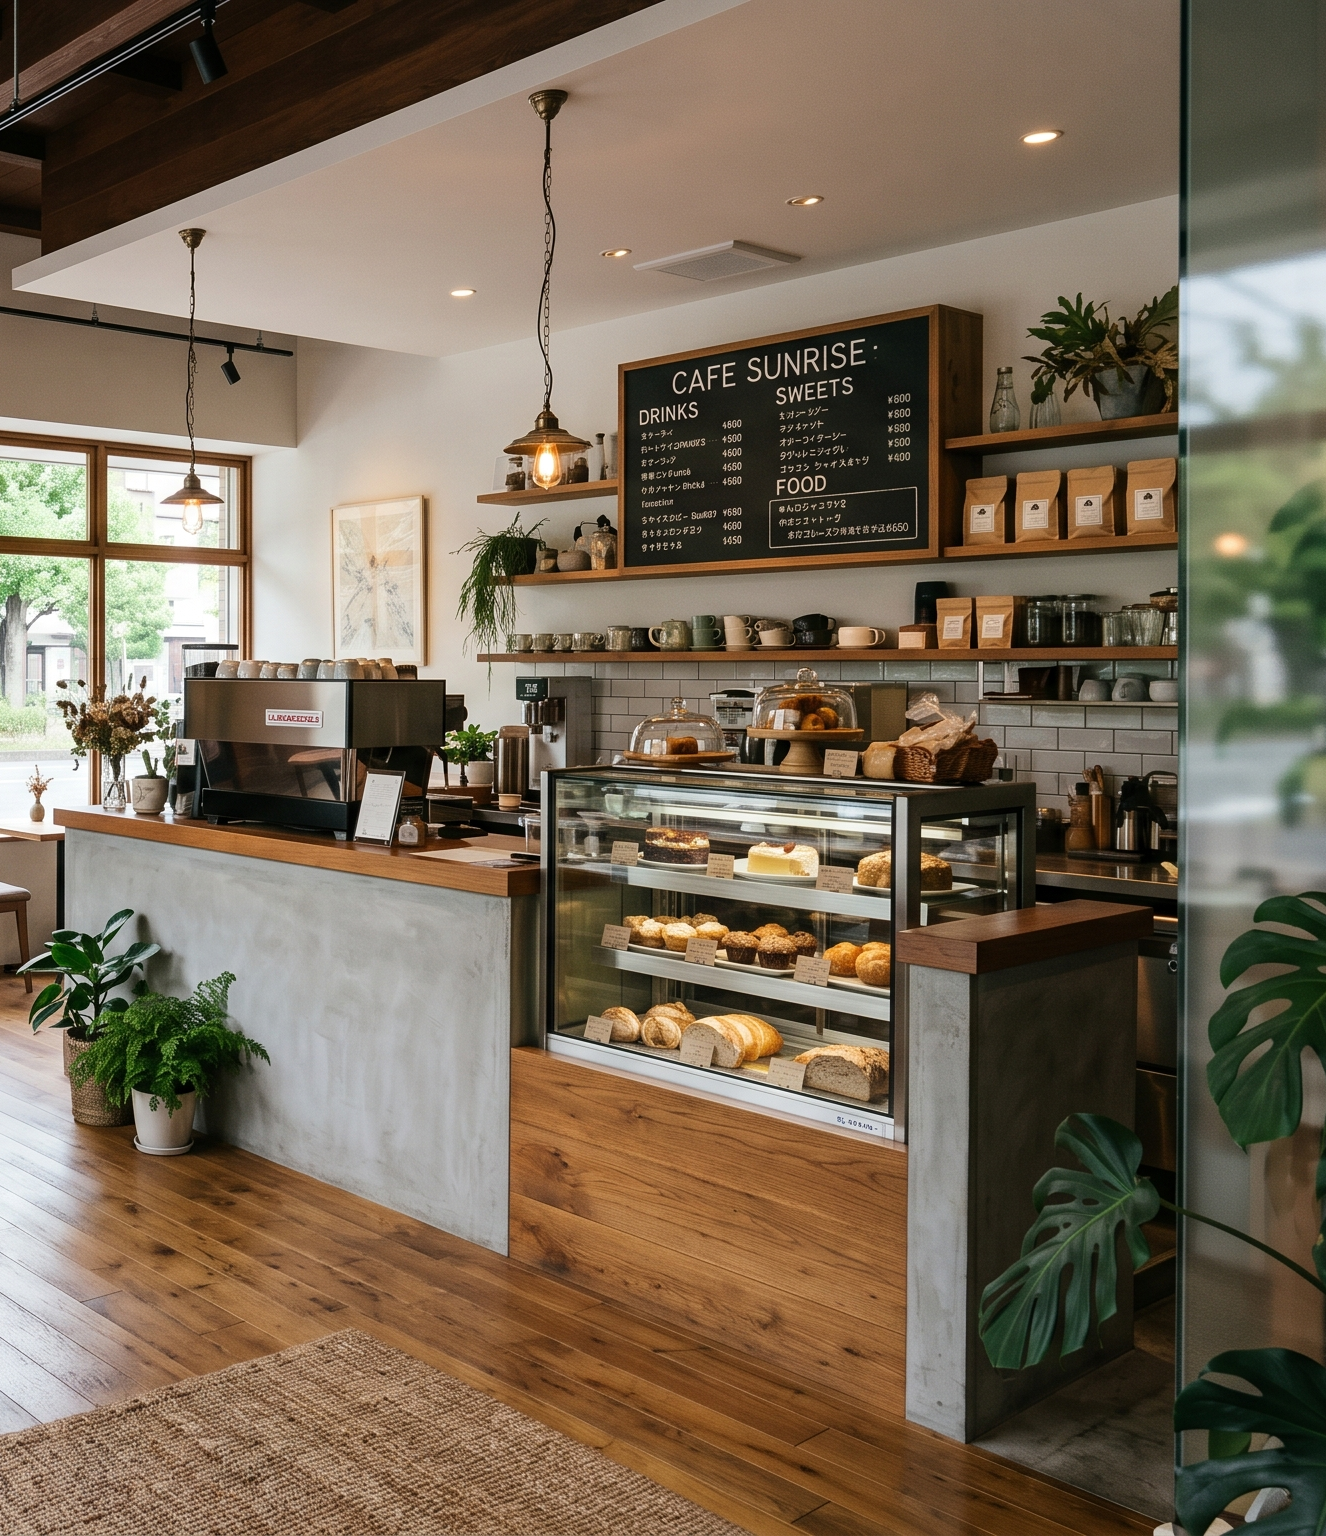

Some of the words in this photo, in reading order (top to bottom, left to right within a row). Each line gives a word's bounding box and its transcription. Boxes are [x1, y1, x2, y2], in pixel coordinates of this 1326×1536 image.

[672, 361, 736, 395] CAFE
[746, 338, 867, 383] SUNRISE
[775, 376, 854, 405] SWEETS
[639, 401, 699, 426] DRINKS
[776, 474, 827, 496] FOOD
